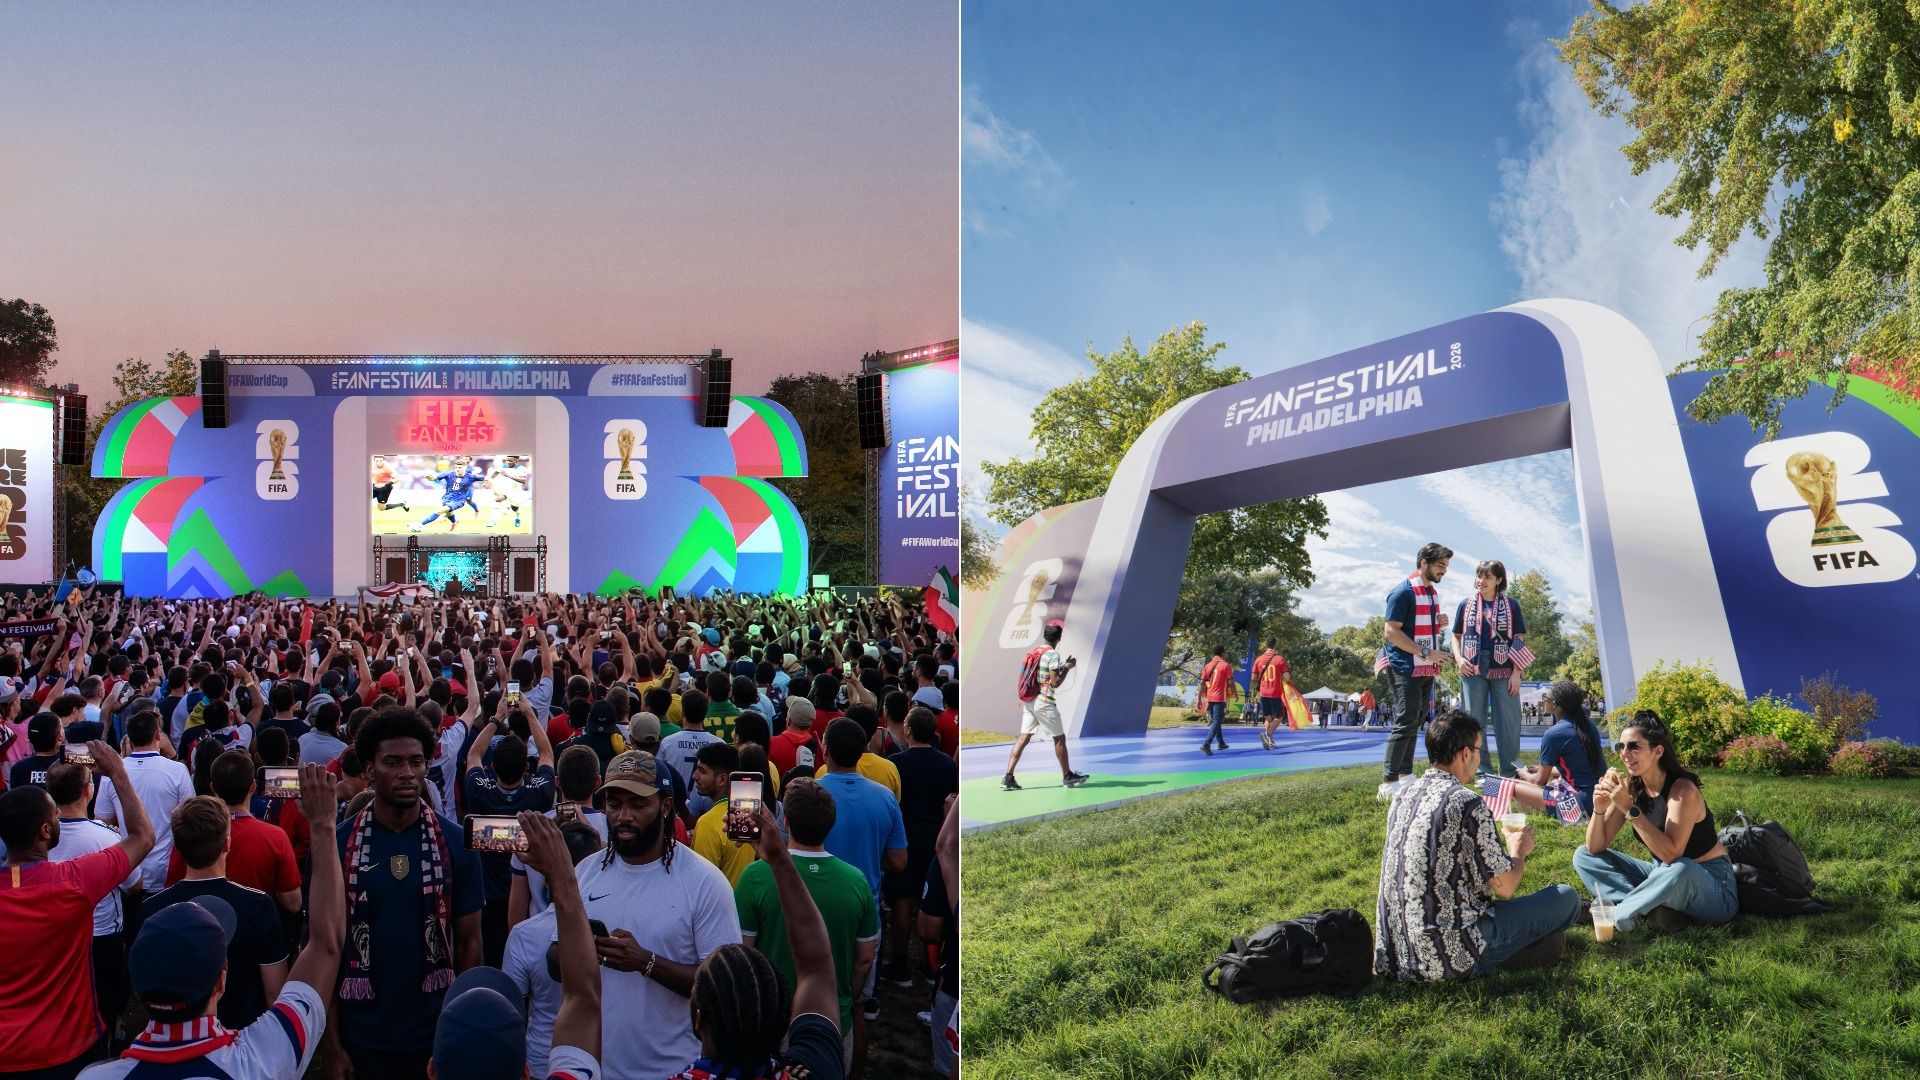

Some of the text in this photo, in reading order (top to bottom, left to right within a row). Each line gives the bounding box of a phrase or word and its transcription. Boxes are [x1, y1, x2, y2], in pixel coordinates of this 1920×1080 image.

[454, 370, 570, 389] PHILADELPHIA
[611, 373, 687, 387] #FIFAFanFestival
[1224, 402, 1239, 428] FIFA
[1450, 342, 1462, 370] 2026
[418, 399, 494, 426] FIFA
[1246, 385, 1424, 447] PHILADELPHIA
[407, 426, 501, 442] FAN FEST
[897, 439, 907, 464] FIFA
[268, 484, 288, 493] FIFA
[616, 483, 636, 493] FIFA
[1813, 550, 1881, 571] FIFA
[1010, 630, 1030, 640] FIFA
